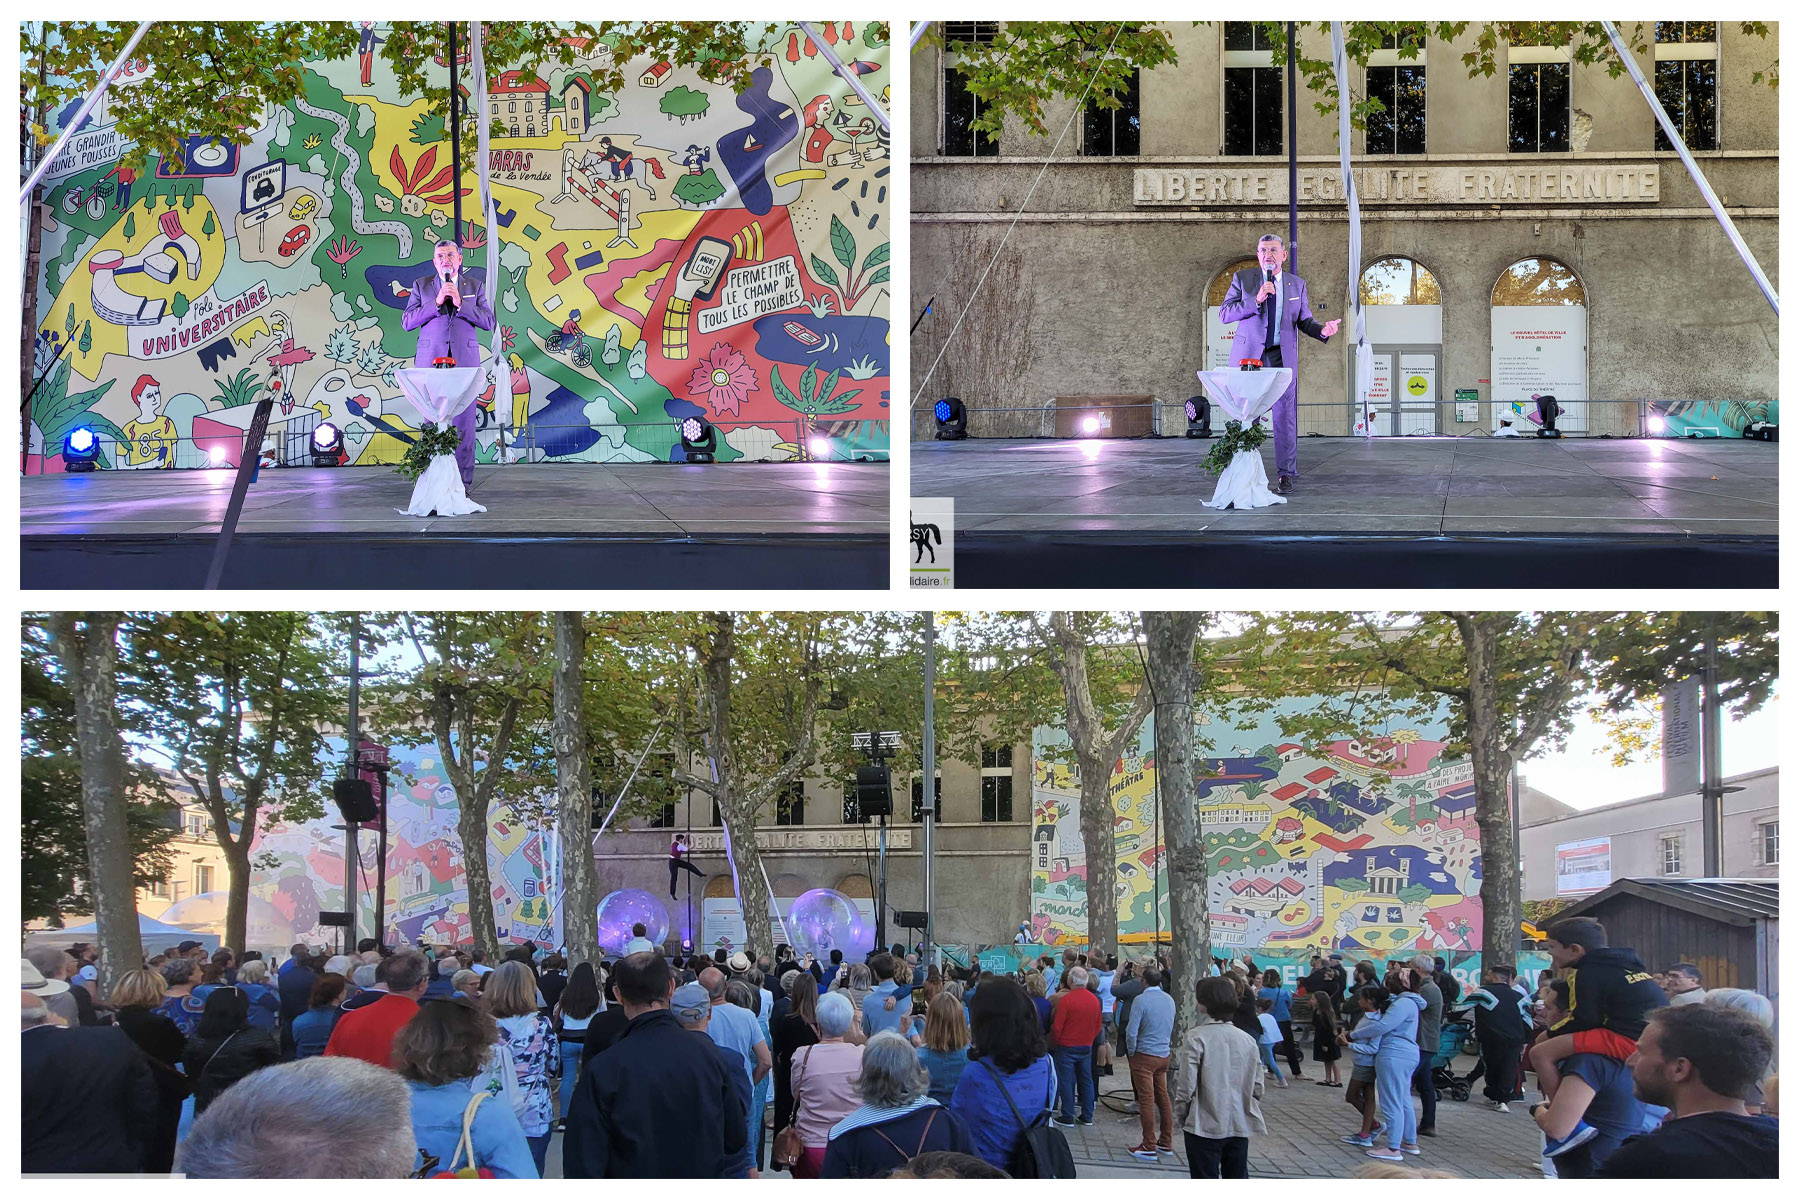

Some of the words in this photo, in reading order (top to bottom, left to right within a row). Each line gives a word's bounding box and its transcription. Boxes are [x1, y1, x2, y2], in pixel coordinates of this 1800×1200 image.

[76, 130, 116, 153] GRANDIR
[45, 155, 76, 175] JEUNES
[81, 144, 116, 165] POUSSES
[1136, 172, 1269, 202] LIBERTE
[1458, 169, 1656, 199] FRATERNITE
[695, 263, 714, 276] LIST
[730, 259, 792, 289] PERMETTRE
[726, 290, 737, 305] LE
[744, 279, 779, 300] CHAMP
[785, 273, 795, 289] DE
[702, 309, 728, 329] TOUS
[732, 303, 748, 320] LES
[754, 288, 800, 314] POSSIBLES
[140, 428, 164, 458] 85
[1433, 777, 1450, 788] FAIRE
[1442, 767, 1453, 777] DES
[1454, 763, 1473, 774] PROJE
